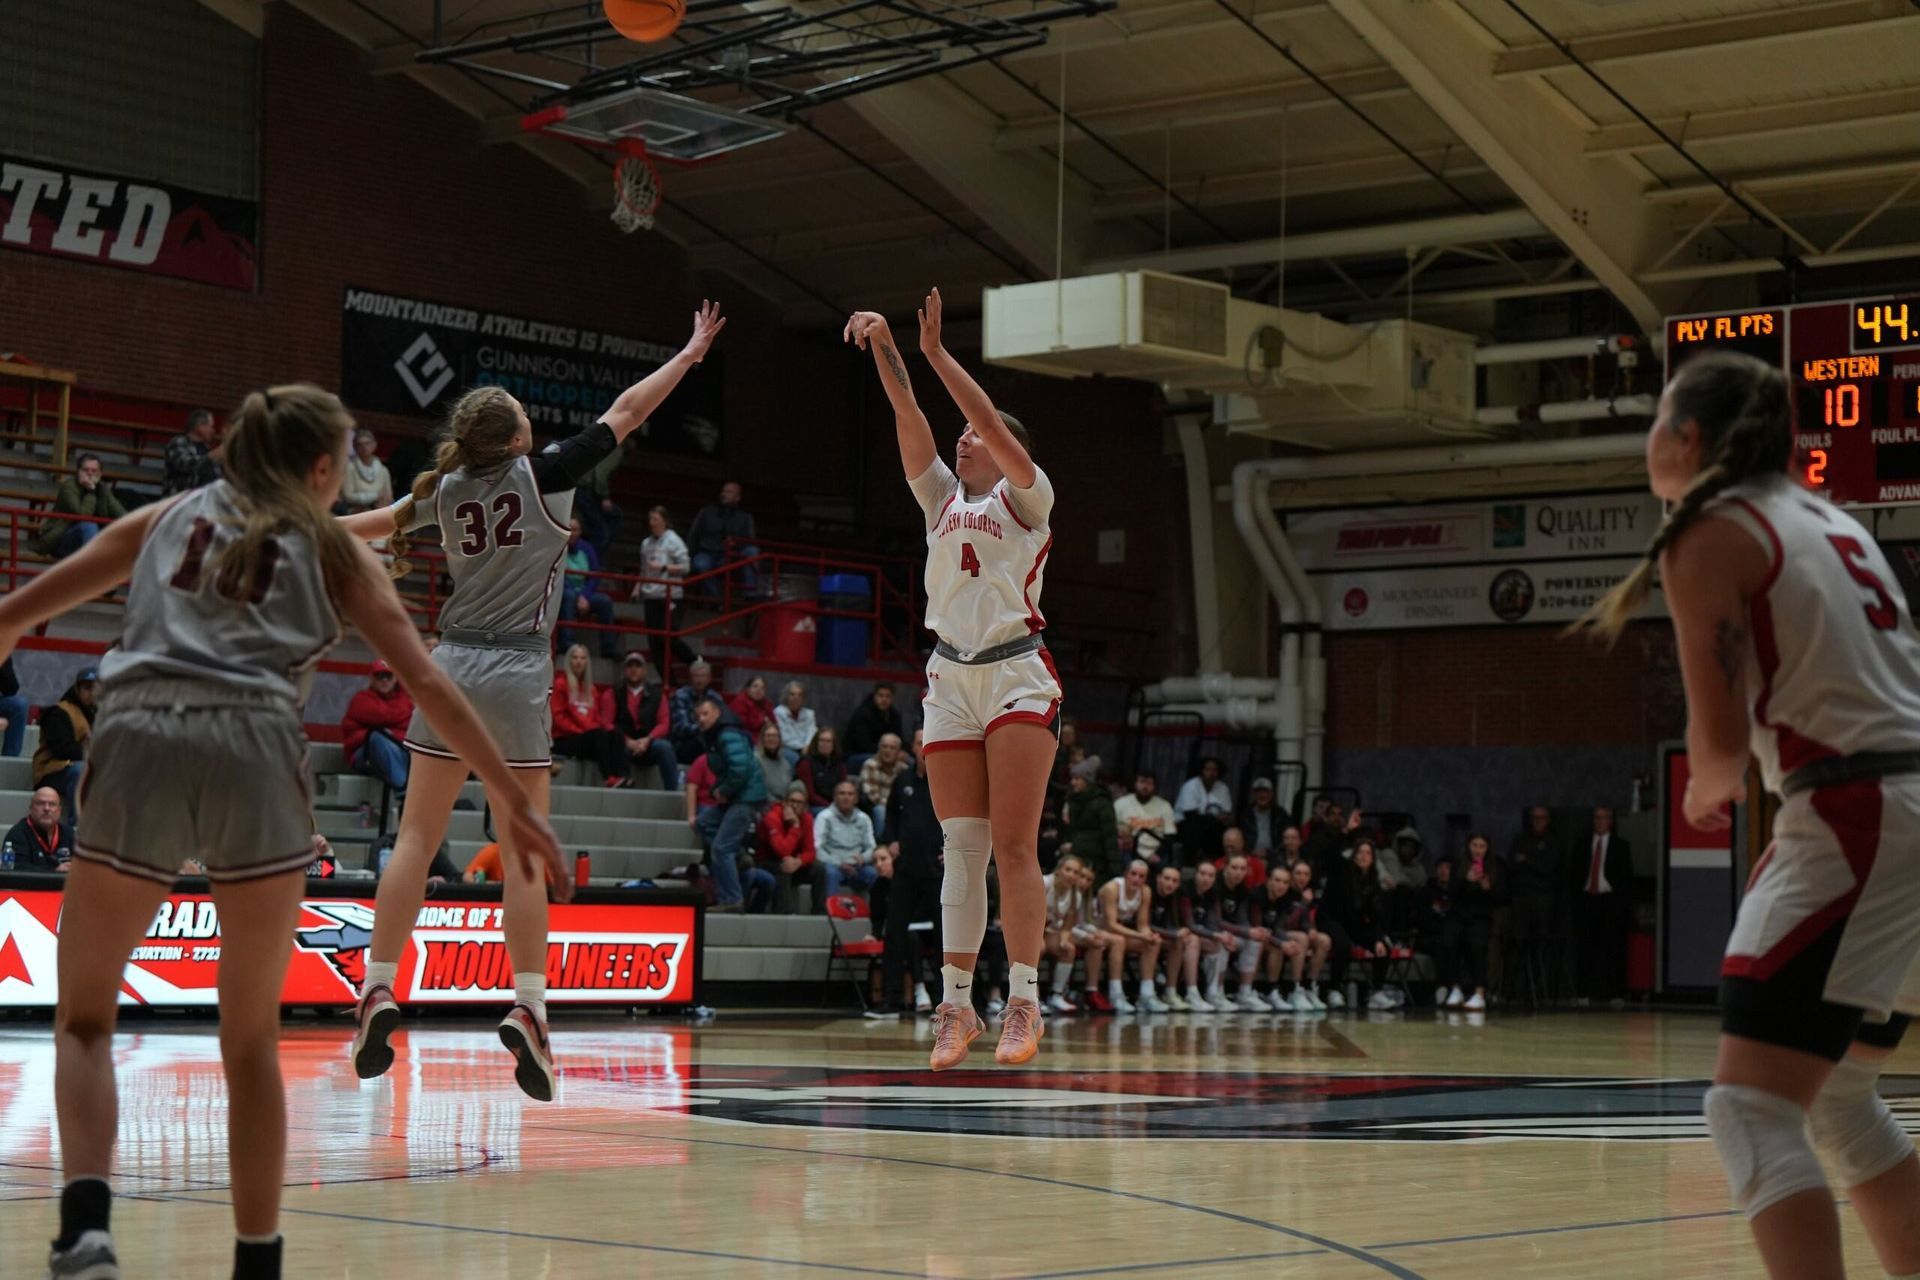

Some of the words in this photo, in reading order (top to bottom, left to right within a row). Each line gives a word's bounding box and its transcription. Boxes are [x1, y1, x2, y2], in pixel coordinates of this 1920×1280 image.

[0, 162, 171, 265] TED
[344, 288, 479, 332] MOUNTAINEER
[480, 314, 578, 349] ATHLETICS
[579, 330, 598, 352] IS
[1676, 319, 1708, 342] PLY
[1715, 317, 1737, 339] FL
[1740, 313, 1774, 336] PTS
[476, 346, 584, 384] GUNNISON
[588, 364, 649, 390] VALLE
[1804, 355, 1880, 382] WESTERN
[477, 371, 614, 409] ORTHOPED
[1824, 384, 1860, 427] 10
[1871, 429, 1903, 444] FOUL
[1808, 450, 1828, 484] 2
[454, 491, 525, 557] 32
[963, 511, 1003, 540] COLORADO
[1537, 505, 1638, 537] QUALITY
[1569, 535, 1606, 550] INN
[961, 543, 981, 577] 4
[1825, 534, 1899, 630] 5
[416, 907, 466, 928] HOME
[467, 908, 492, 928] OF
